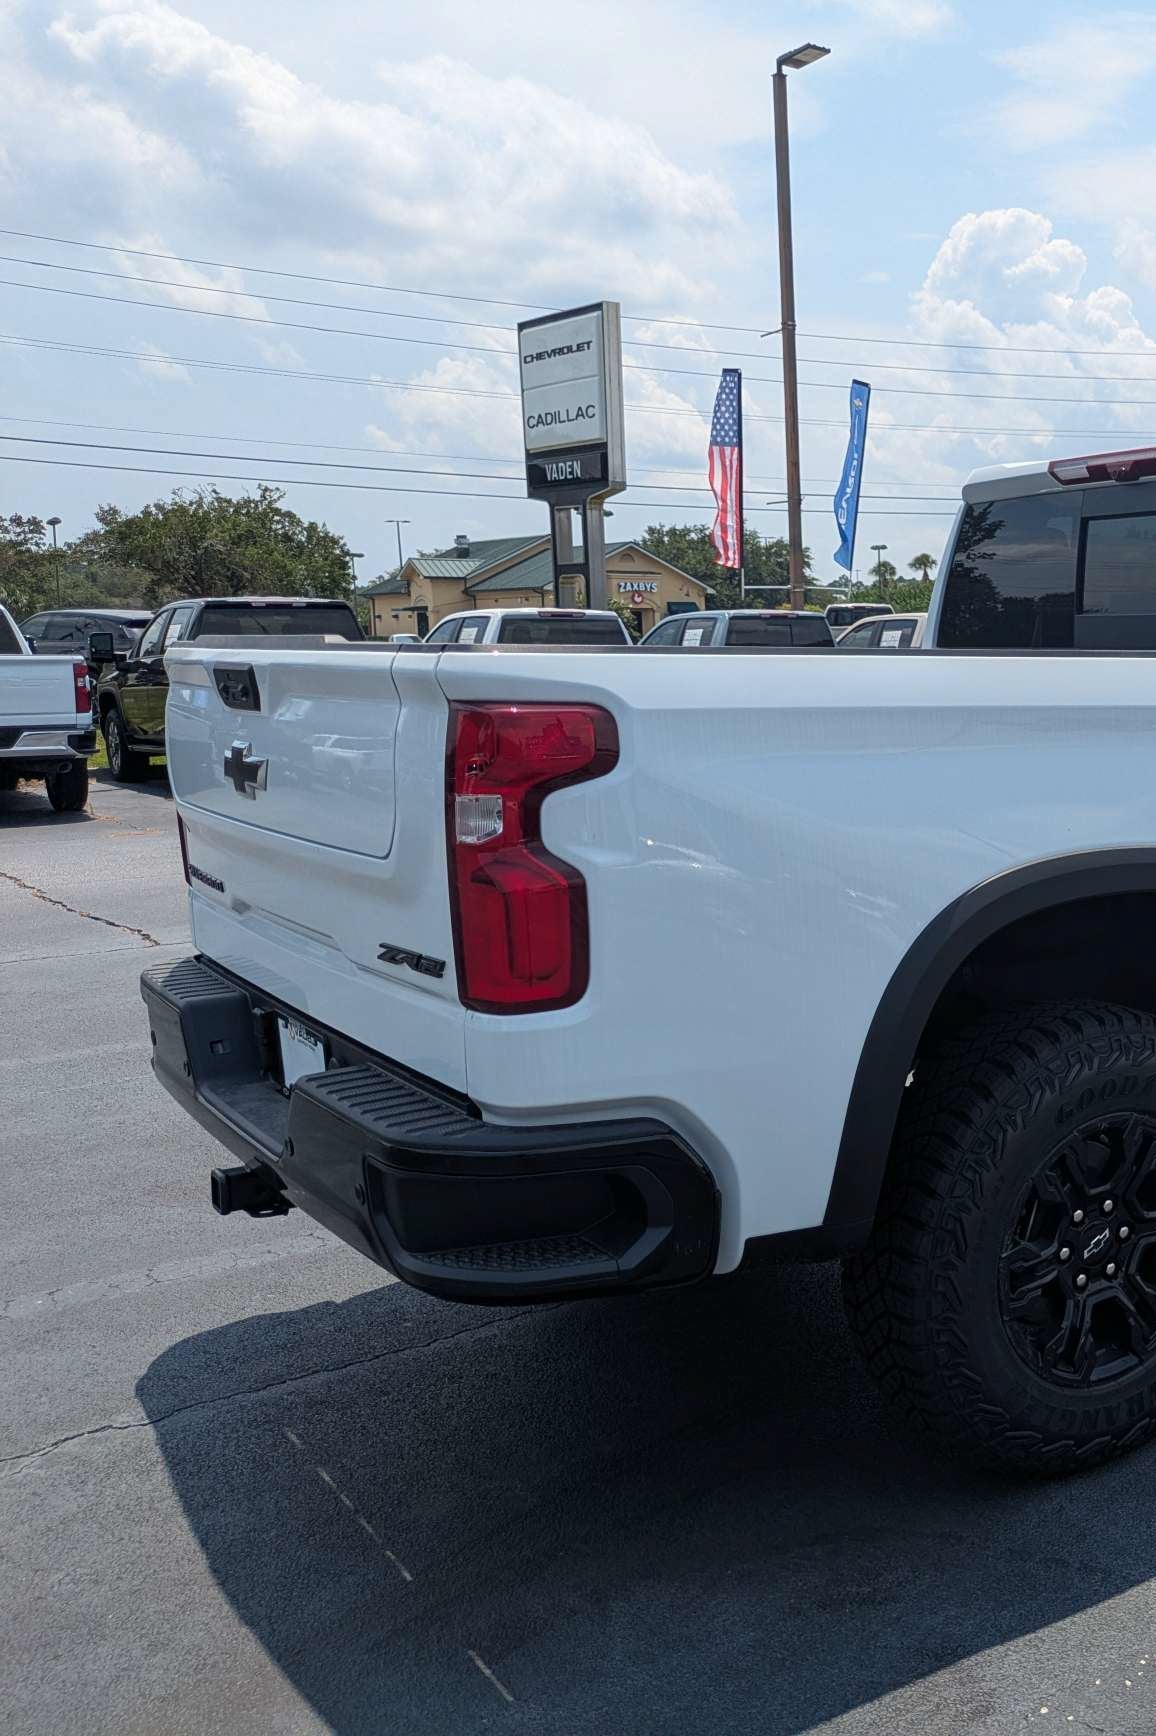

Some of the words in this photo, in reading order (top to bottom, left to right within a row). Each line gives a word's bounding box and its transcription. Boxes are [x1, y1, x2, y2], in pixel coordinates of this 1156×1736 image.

[523, 340, 593, 365] CHEVROLET
[527, 404, 596, 429] CADILLAC
[544, 460, 582, 481] VADEN
[617, 581, 658, 593] ZAXBYS
[377, 942, 446, 978] ZR2
